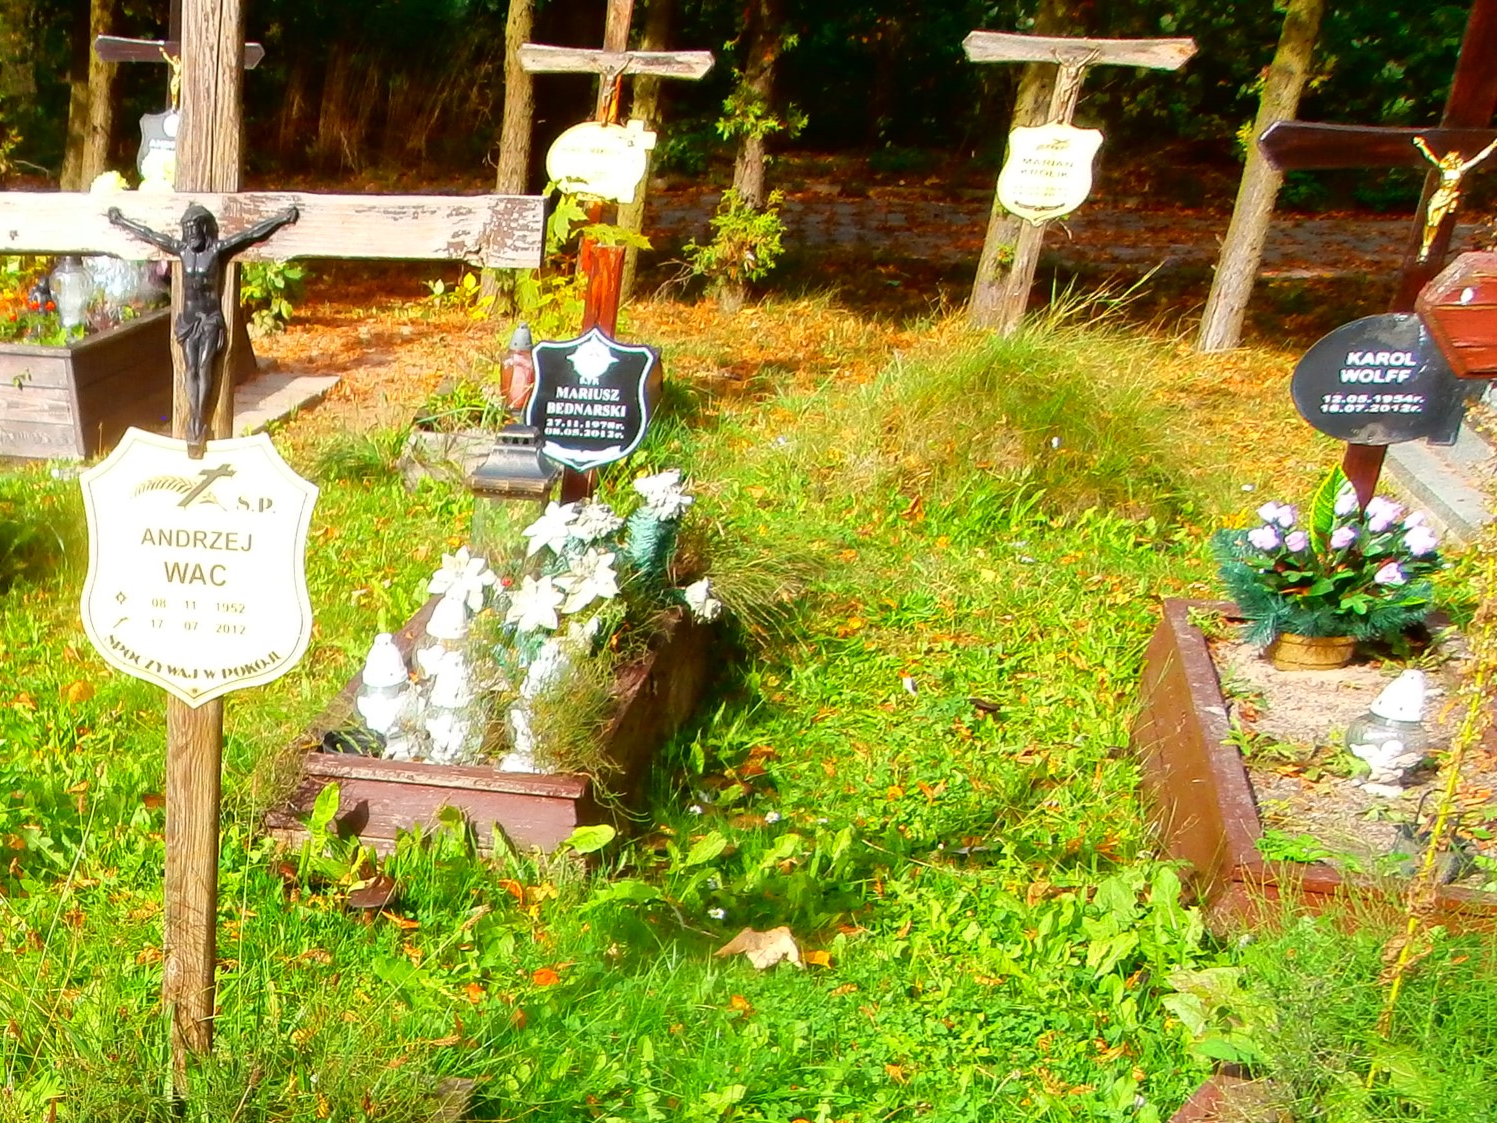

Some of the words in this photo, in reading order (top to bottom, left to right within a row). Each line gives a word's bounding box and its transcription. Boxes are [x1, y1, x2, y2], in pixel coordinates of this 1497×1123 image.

[1346, 352, 1417, 367] KAROL
[1339, 368, 1413, 383] WOLFF
[555, 386, 620, 401] MARIUSZ
[546, 401, 627, 418] BEDNARSKI
[141, 528, 252, 552] ANDRZEJ
[164, 561, 227, 586] WAC
[184, 600, 197, 611] 11
[215, 602, 246, 614] 1952
[151, 618, 164, 629] 17
[184, 621, 199, 632] 07
[215, 623, 246, 635] 2012
[203, 669, 216, 680] W
